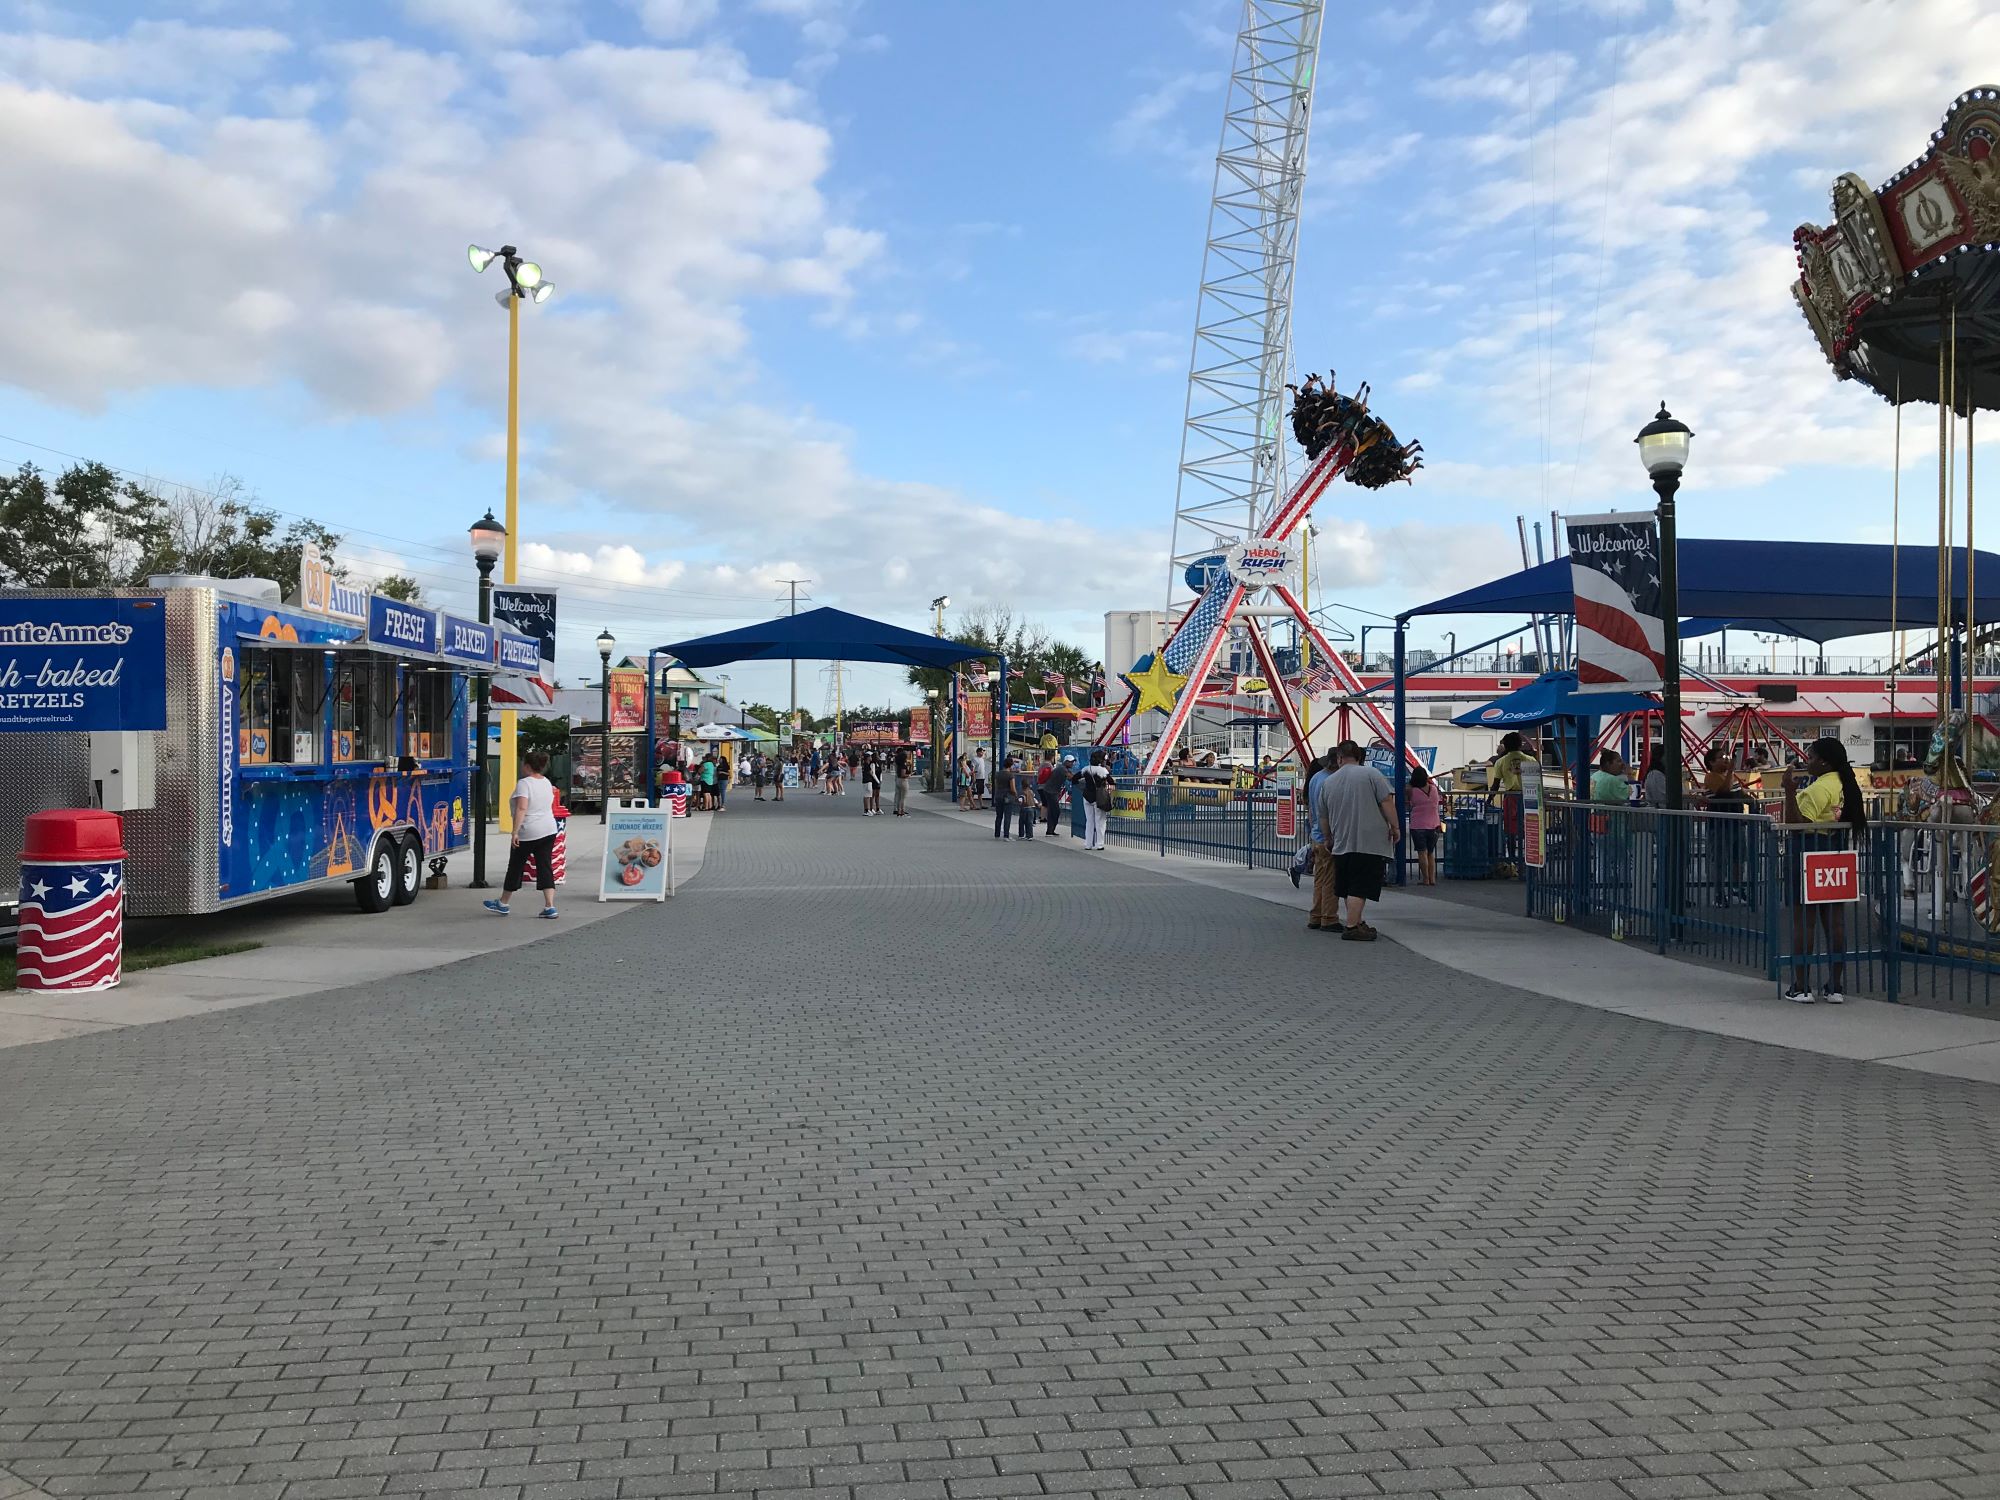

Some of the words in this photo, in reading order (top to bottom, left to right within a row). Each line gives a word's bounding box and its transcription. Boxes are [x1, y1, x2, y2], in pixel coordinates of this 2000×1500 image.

[1576, 529, 1651, 554] Welcome!
[1240, 558, 1286, 568] RUSH
[1249, 548, 1280, 558] HEAD
[329, 579, 369, 618] Aunt
[499, 596, 550, 614] Welcome!
[384, 607, 426, 644] FRESH
[454, 625, 487, 655] BAKED
[502, 638, 539, 667] PRETZELS
[0, 657, 124, 688] h-baked
[1502, 708, 1545, 721] pepsi
[611, 823, 641, 831] LEMONADE
[1814, 866, 1849, 888] EXIT
